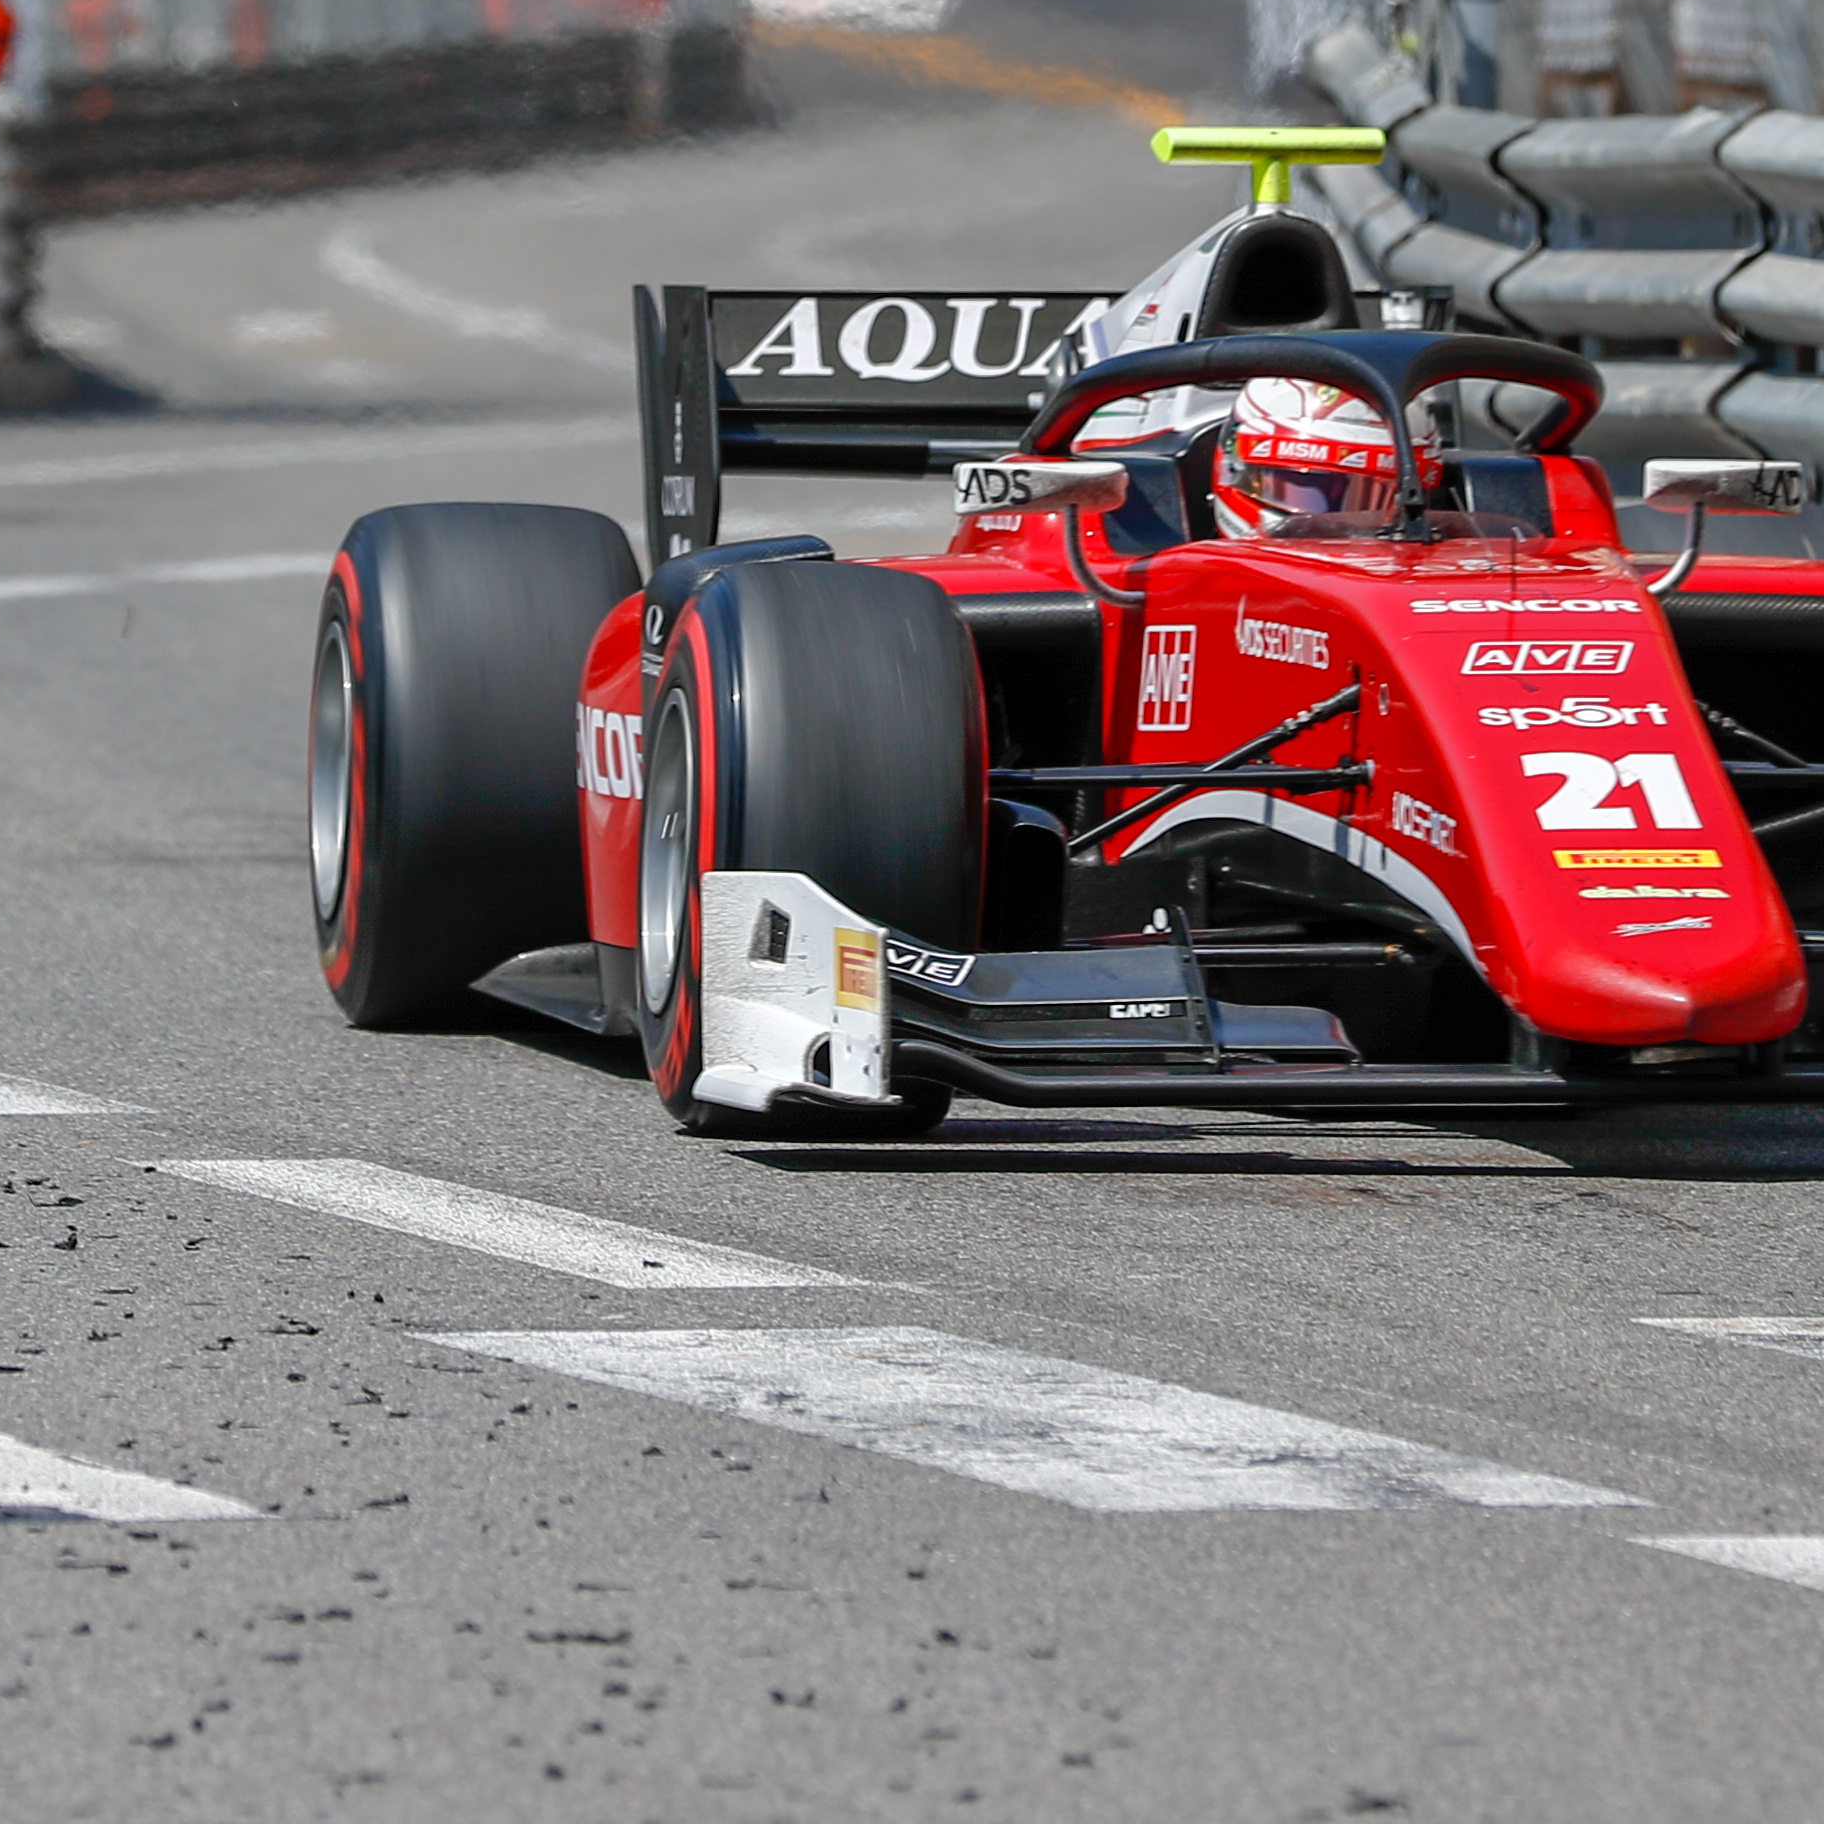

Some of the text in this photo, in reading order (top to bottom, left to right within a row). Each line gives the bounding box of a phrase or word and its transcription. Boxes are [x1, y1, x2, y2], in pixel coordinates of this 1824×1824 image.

[1277, 440, 1329, 460] MSM
[957, 469, 1032, 504] ADS
[1409, 599, 1642, 613] SENCOR
[1470, 646, 1624, 669] AVE
[1140, 650, 1191, 704] AVE
[1520, 751, 1703, 830] 21
[1569, 853, 1700, 865] PIRELLI
